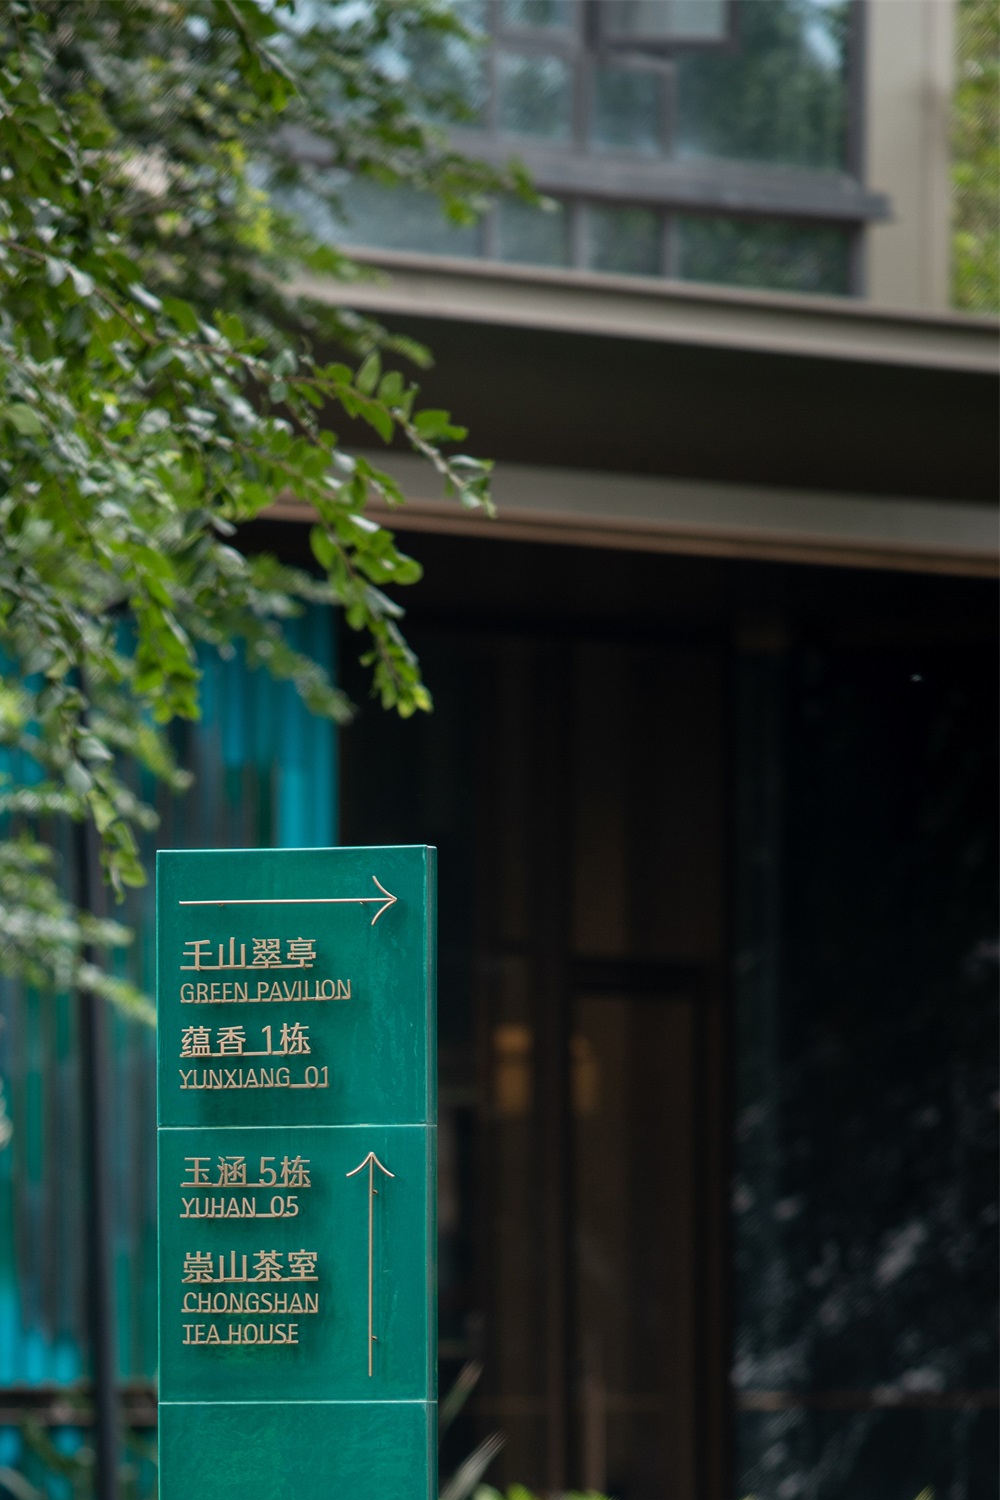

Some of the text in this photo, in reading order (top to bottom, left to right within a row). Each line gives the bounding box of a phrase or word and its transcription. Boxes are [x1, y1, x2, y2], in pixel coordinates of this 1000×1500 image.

[181, 937, 316, 970] 千山翠亭
[180, 979, 351, 1003] GREEN PAVILION
[179, 1067, 290, 1089] YUNXIANG
[181, 1197, 256, 1218] YUHAN
[182, 1249, 319, 1283] 崇山茶室
[181, 1292, 319, 1314] CHONGSHAN
[182, 1324, 298, 1345] TEA HOUSE
